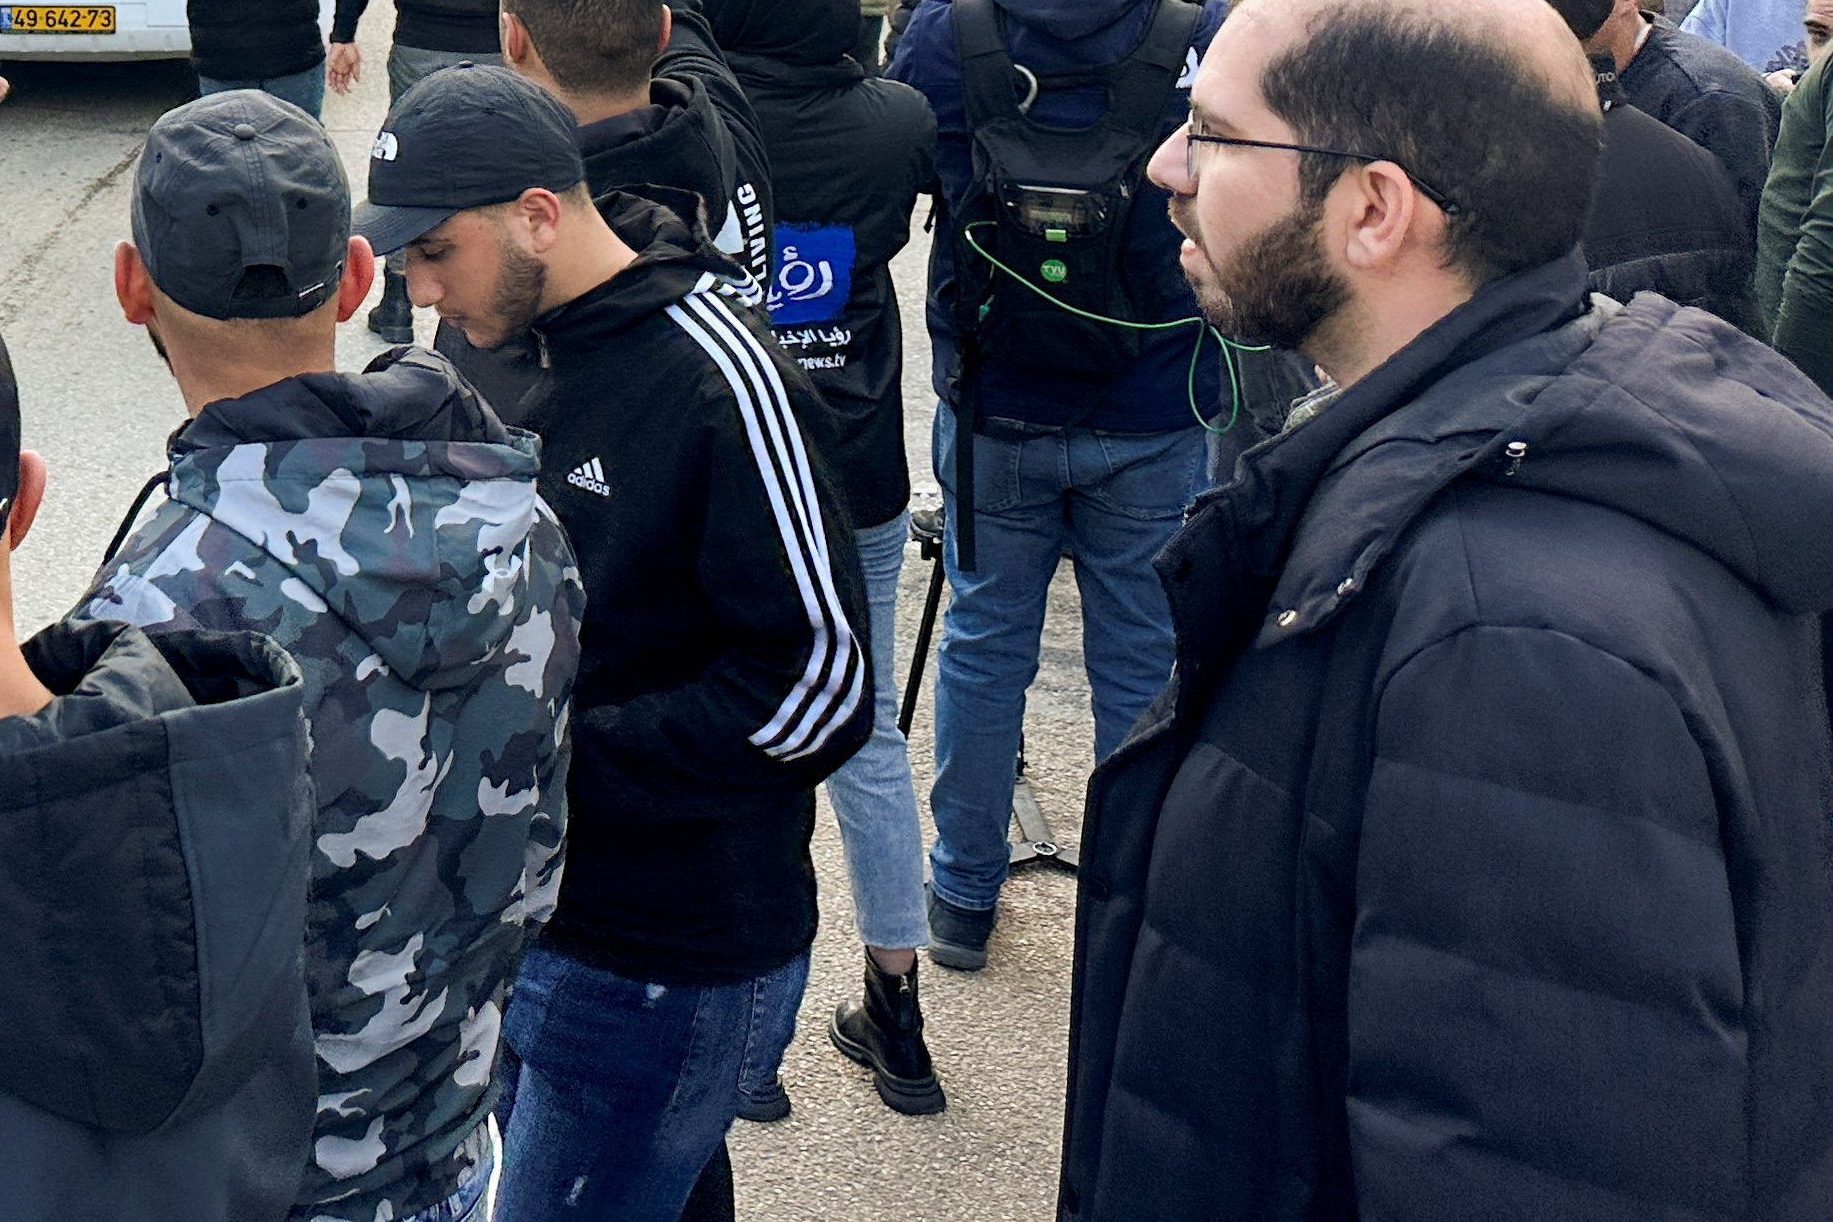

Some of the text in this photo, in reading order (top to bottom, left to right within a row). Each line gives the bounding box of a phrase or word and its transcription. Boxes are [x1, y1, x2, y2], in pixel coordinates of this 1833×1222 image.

[736, 182, 767, 282] LIVING
[817, 325, 852, 347] رؤيا
[567, 472, 611, 497] adidas
